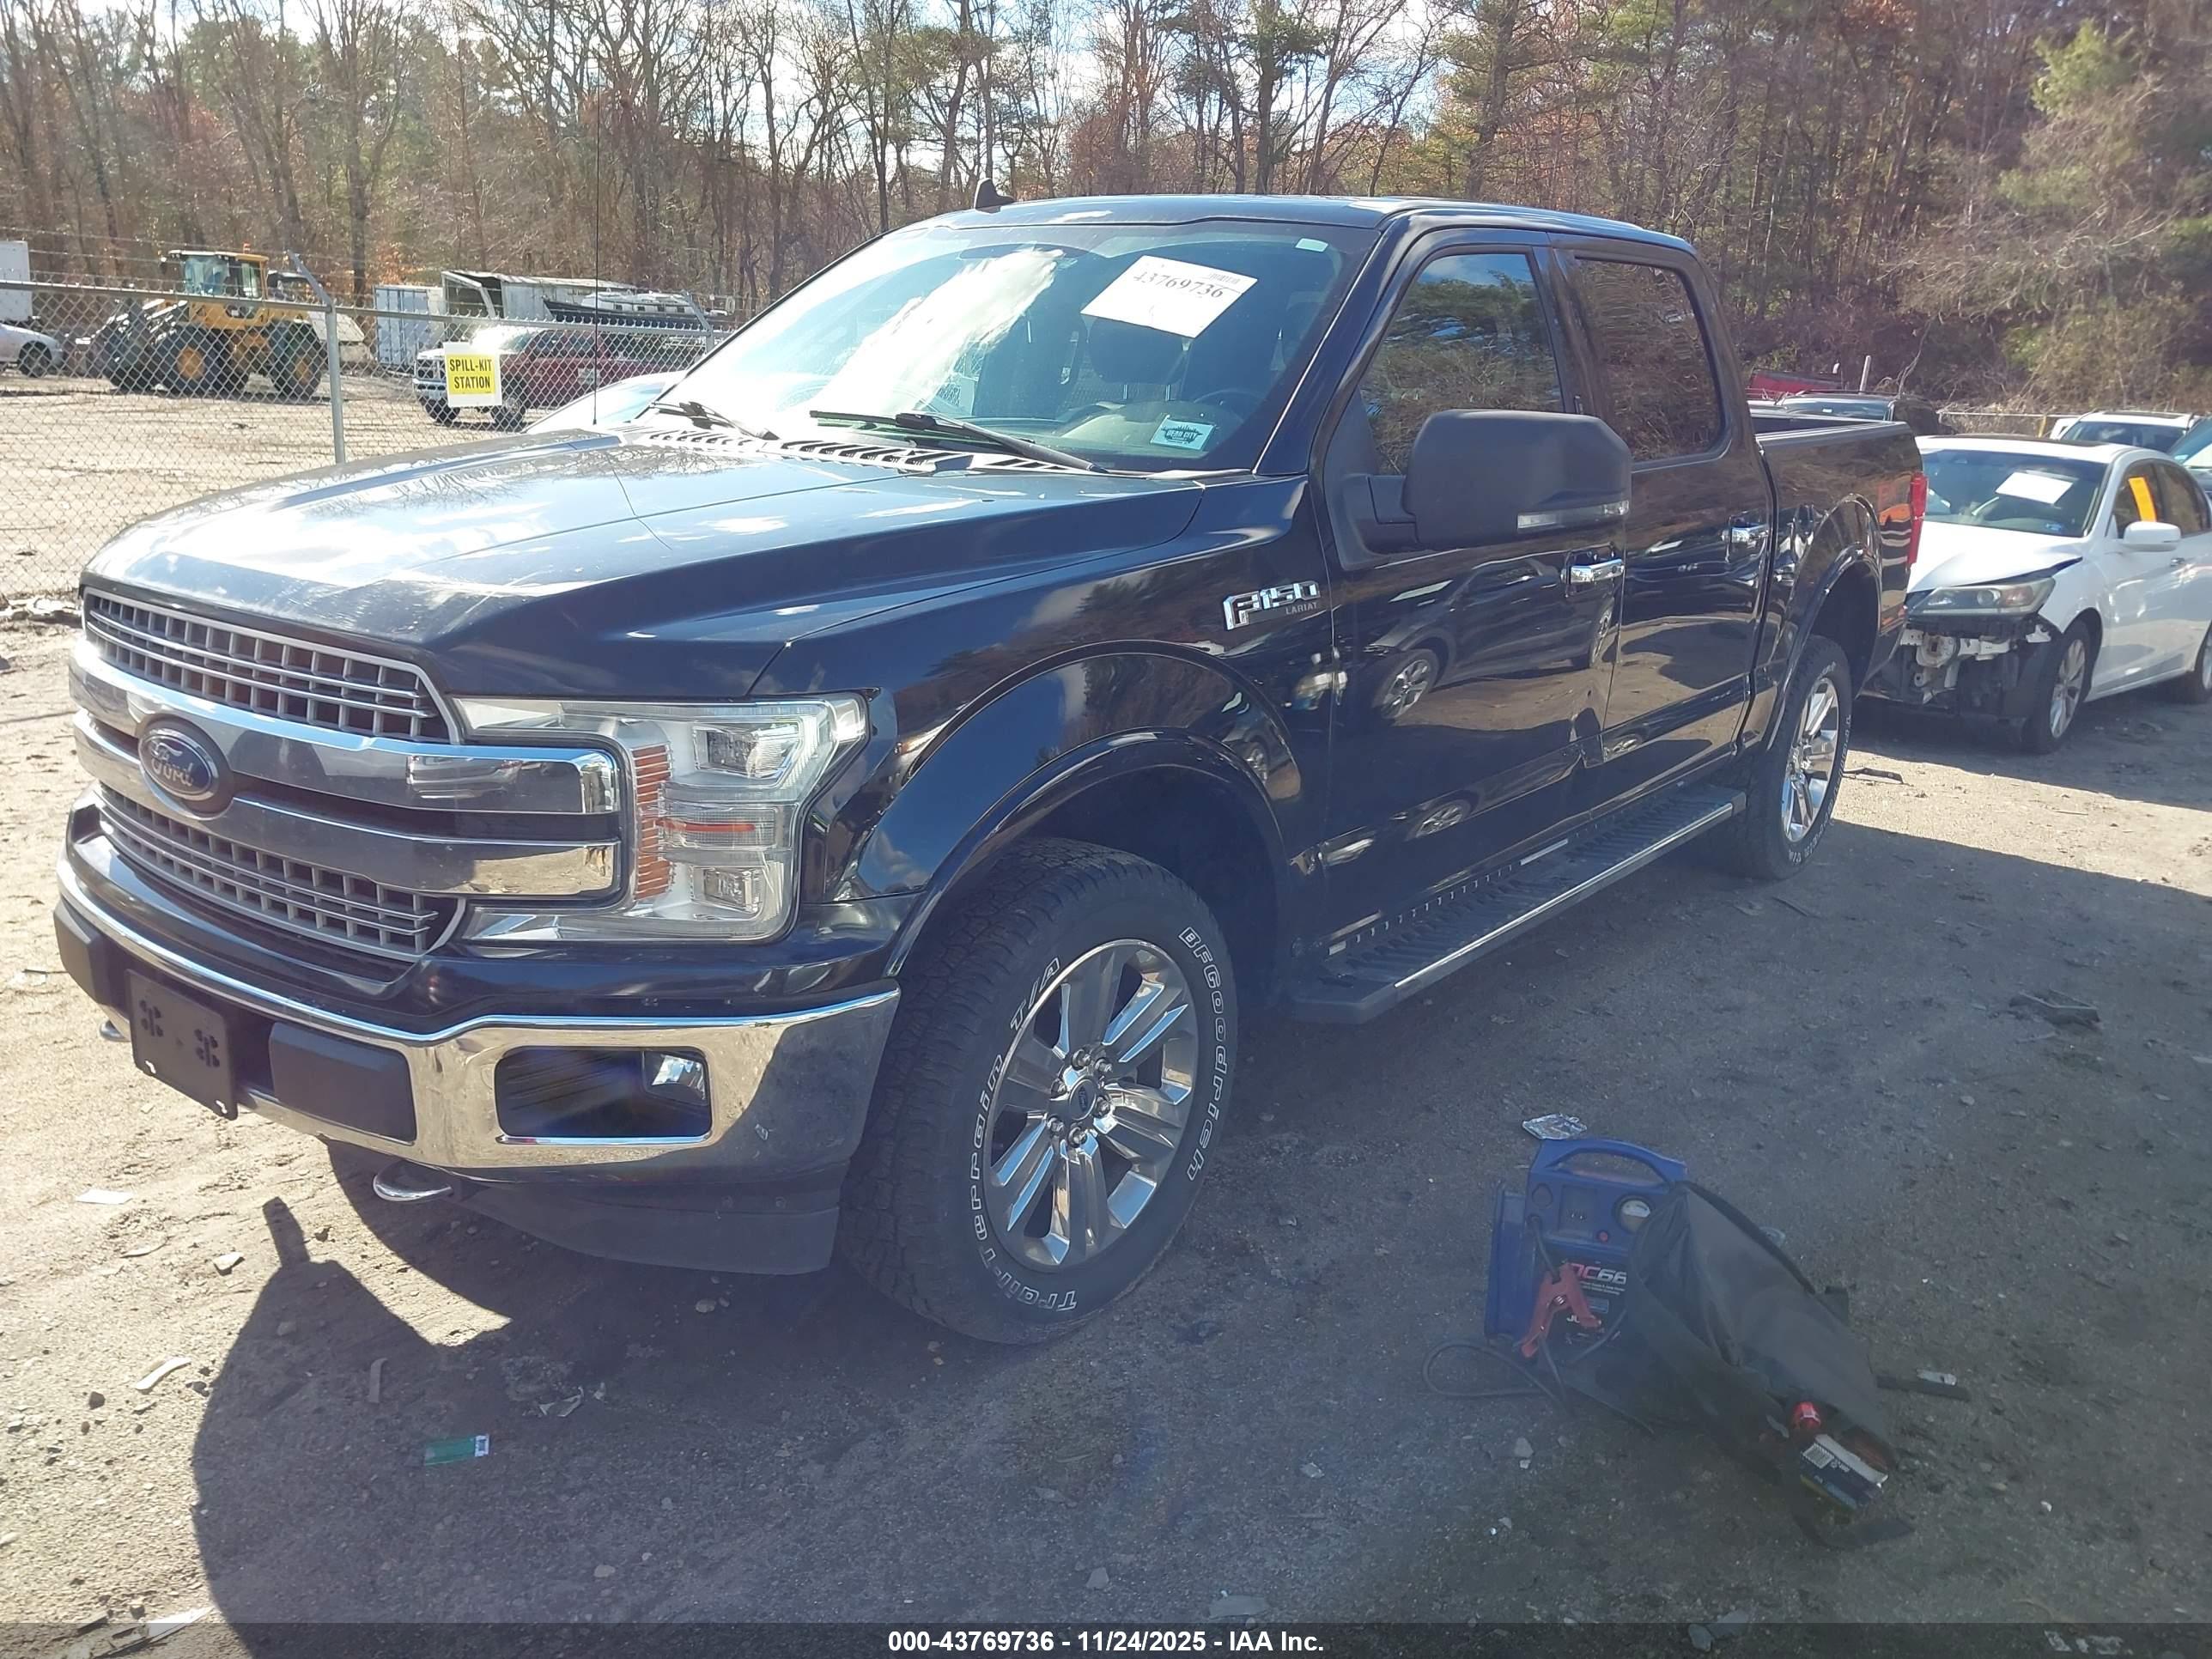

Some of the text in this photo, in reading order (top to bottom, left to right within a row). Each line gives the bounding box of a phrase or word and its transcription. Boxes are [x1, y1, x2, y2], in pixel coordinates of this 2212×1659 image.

[1133, 270, 1224, 299] 43769736
[449, 358, 493, 372] SPILL-KIT
[453, 376, 490, 389] STATION
[1285, 602, 1319, 615] LARIAT
[150, 739, 193, 787] Ford
[1010, 957, 1061, 1031] T/A
[1178, 927, 1228, 1182] BFGoodrich
